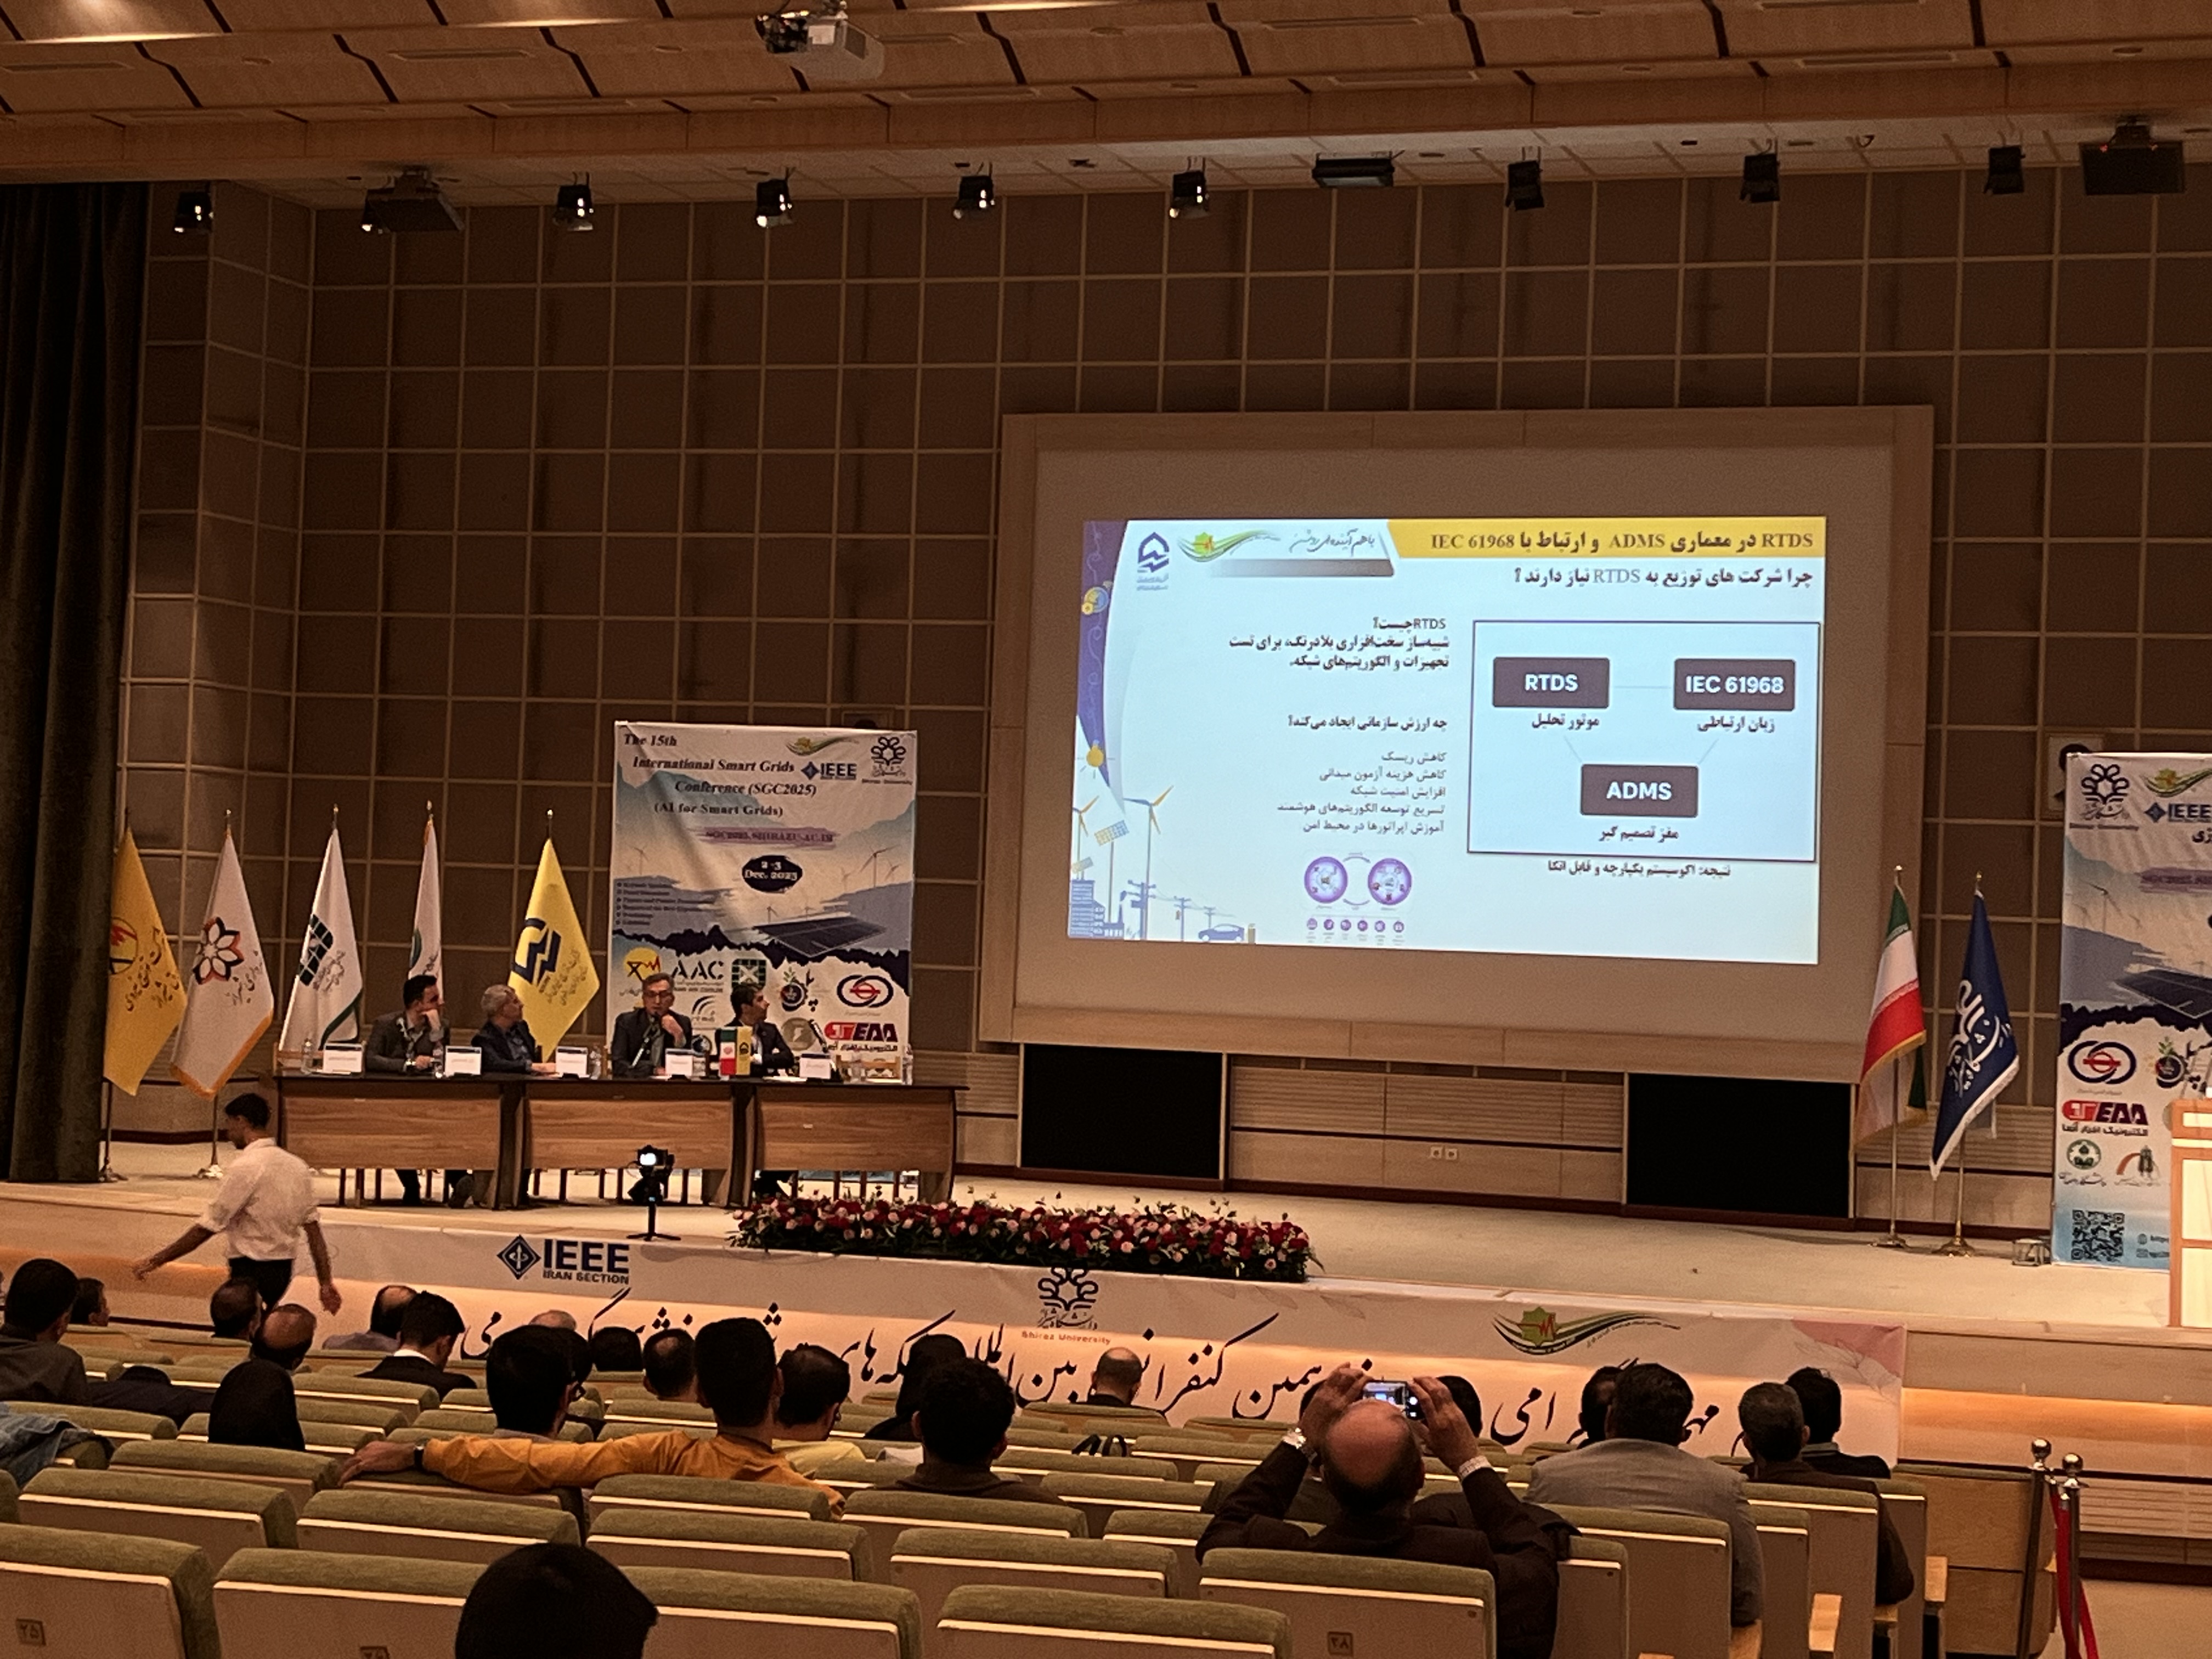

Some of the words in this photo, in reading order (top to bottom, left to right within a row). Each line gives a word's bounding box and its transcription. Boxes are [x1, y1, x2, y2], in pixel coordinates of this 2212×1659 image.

[1431, 534, 1464, 548] IEC
[1469, 533, 1515, 548] 61968
[1519, 532, 1532, 553] با
[1537, 531, 1586, 553] ارتباط
[1590, 537, 1600, 553] و
[1609, 534, 1666, 548] ADMS
[1670, 531, 1732, 553] معماری
[1736, 534, 1756, 553] در
[1762, 534, 1813, 548] RTDS
[1525, 567, 1562, 588] دارند
[1566, 568, 1590, 588] نیاز
[1593, 569, 1641, 583] RTDS
[1645, 569, 1659, 585] به
[1662, 568, 1702, 588] توزیع
[1705, 568, 1735, 588] های
[1739, 567, 1784, 588] شرکت
[1788, 568, 1814, 588] چرا
[1229, 634, 1254, 647] تست
[1256, 635, 1282, 651] برای
[1393, 660, 1401, 671] و
[1402, 654, 1449, 672] تجهیزات
[1524, 673, 1579, 692] RTDS
[1685, 675, 1721, 693] IEC
[1725, 675, 1785, 694] 61968
[1328, 716, 1356, 730] ایجاد
[1357, 715, 1399, 732] سازمانی
[1400, 716, 1430, 732] ارزش
[1432, 719, 1447, 731] چه
[1531, 712, 1566, 729] تحلیل
[1568, 713, 1600, 730] موتور
[1697, 714, 1745, 732] ارتباطی
[1748, 718, 1775, 733] زبان
[624, 733, 646, 746] The
[650, 734, 678, 747] 15th
[633, 755, 715, 771] International
[718, 759, 757, 772] Smart
[759, 760, 795, 773] Grids
[1381, 751, 1414, 765] ریسک
[1417, 751, 1447, 765] کاهش
[820, 763, 857, 777] IEEE
[1319, 767, 1352, 782] میدانی
[1354, 765, 1384, 781] آزمون
[1386, 770, 1414, 782] هزینه
[1416, 769, 1447, 782] کاهش
[675, 781, 746, 794] Conference
[748, 783, 817, 798] (SGC2025)
[1350, 785, 1378, 798] شبکه
[1412, 786, 1446, 800] افزایش
[1606, 781, 1672, 801] ADMS
[654, 802, 675, 815] (AI
[678, 802, 697, 814] for
[701, 803, 740, 815] Smart
[742, 804, 784, 818] Grids)
[2168, 803, 2212, 819] IEEE
[1303, 819, 1321, 833] امن
[1323, 820, 1350, 833] محیط
[1352, 822, 1365, 833] در
[1410, 820, 1444, 835] آموزش
[1598, 825, 1619, 841] گیر
[1620, 825, 1656, 842] تصمیم
[1657, 827, 1679, 843] مغز
[744, 869, 768, 879] Dec.
[672, 960, 725, 980] AAC
[544, 1239, 630, 1274] IEEE
[543, 1269, 573, 1280] IRAN
[576, 1272, 629, 1285] SECTION
[1021, 1330, 1055, 1341] Shiraz
[1058, 1333, 1111, 1345] University
